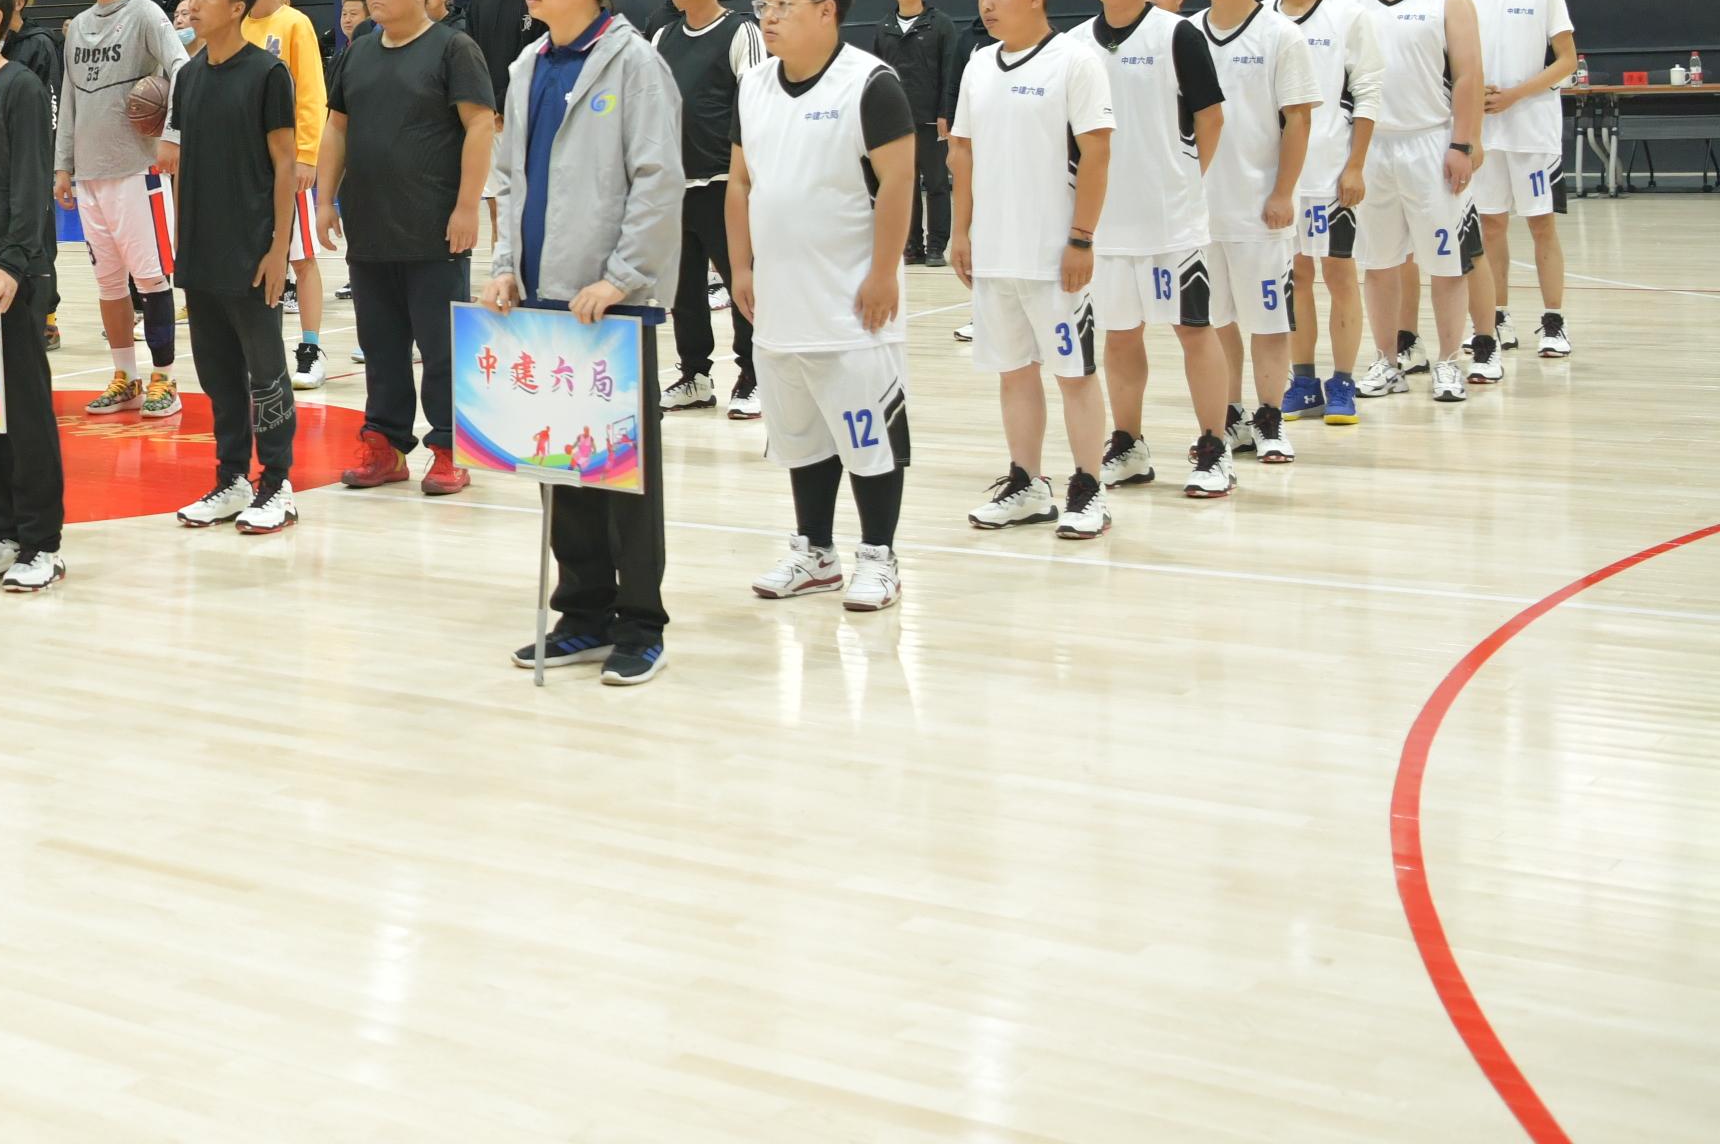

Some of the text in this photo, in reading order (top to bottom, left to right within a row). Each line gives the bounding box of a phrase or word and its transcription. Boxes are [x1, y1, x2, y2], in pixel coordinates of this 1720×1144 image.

[74, 44, 122, 65] BUCKS
[1308, 38, 1331, 47] 建六局
[1121, 56, 1154, 65] 中建六局
[1233, 56, 1264, 65] 中建六局
[1011, 86, 1045, 97] 中建六局
[805, 109, 839, 121] 中建六局
[1529, 169, 1545, 197] 11
[1434, 228, 1451, 255] 2
[1152, 267, 1172, 301] 13
[1261, 279, 1278, 310] 5
[1055, 322, 1073, 356] 3
[477, 347, 613, 401] 中建六局
[843, 409, 879, 448] 12
